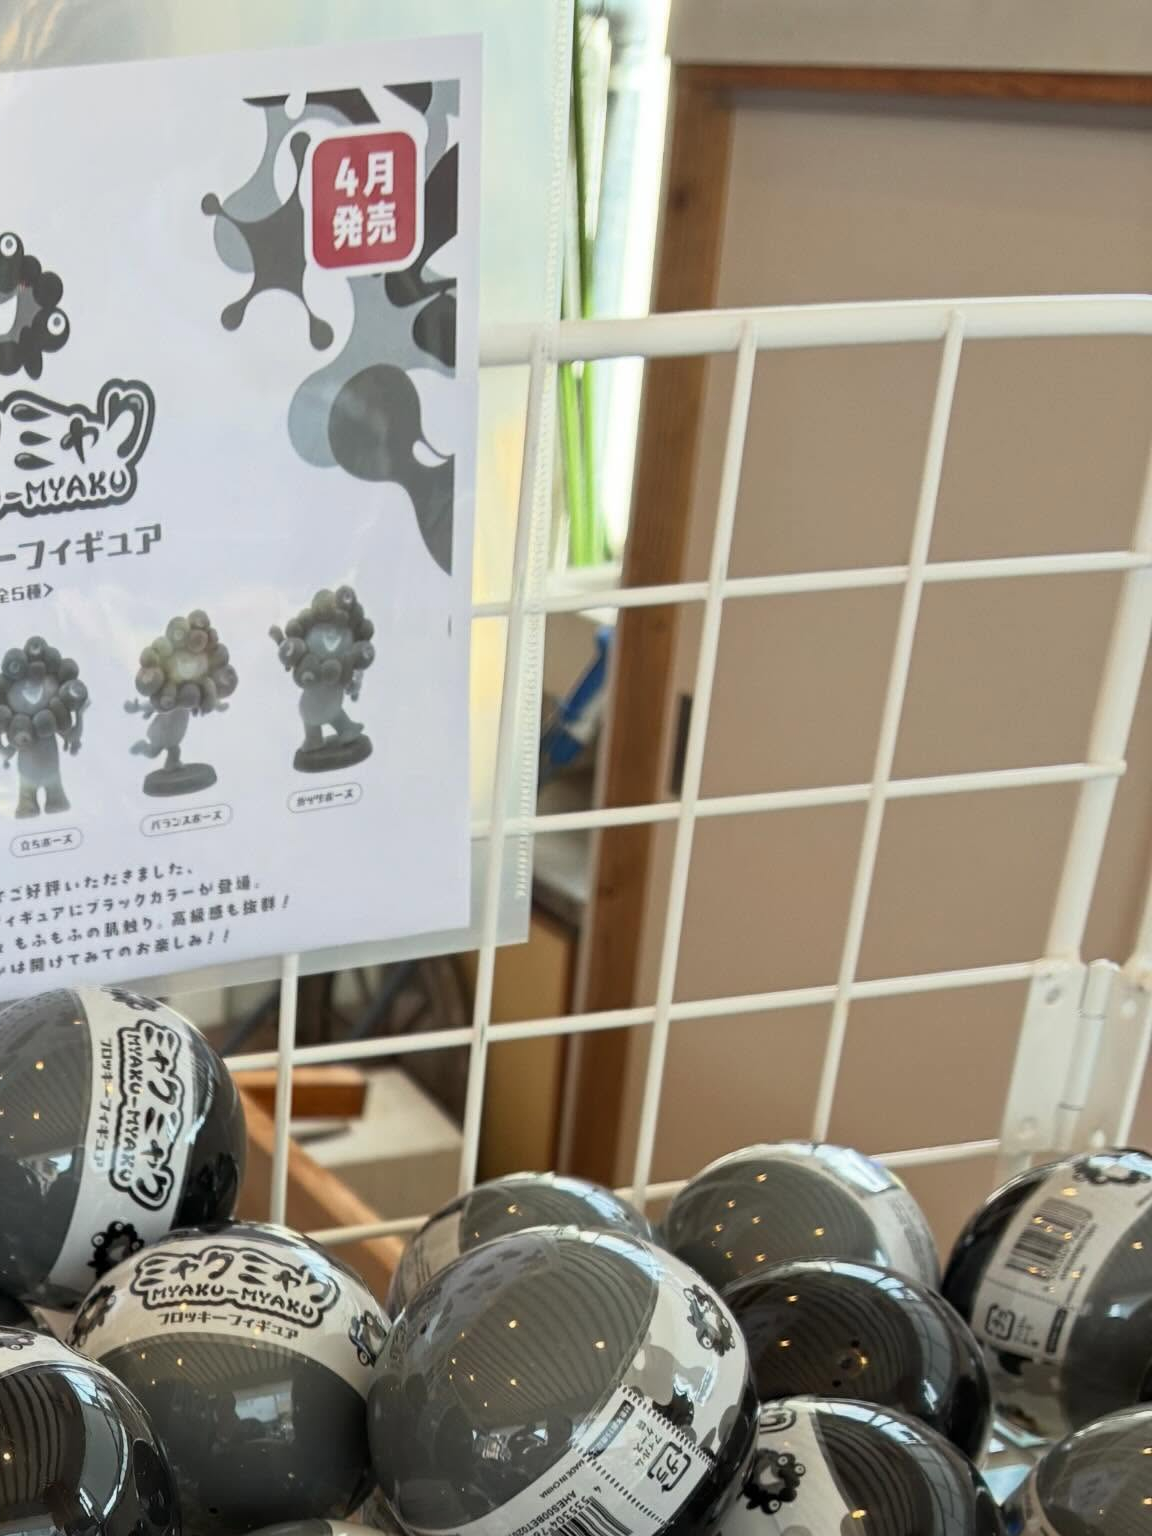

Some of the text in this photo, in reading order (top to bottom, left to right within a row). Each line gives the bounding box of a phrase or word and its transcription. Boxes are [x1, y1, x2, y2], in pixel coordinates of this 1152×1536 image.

[334, 150, 396, 198] 4月
[332, 202, 397, 251] 発売
[118, 1033, 144, 1183] MYAKU-MYAKU
[151, 1282, 315, 1320] MYAKU-MYAKU
[157, 1310, 299, 1340] フロッキーフィギュア
